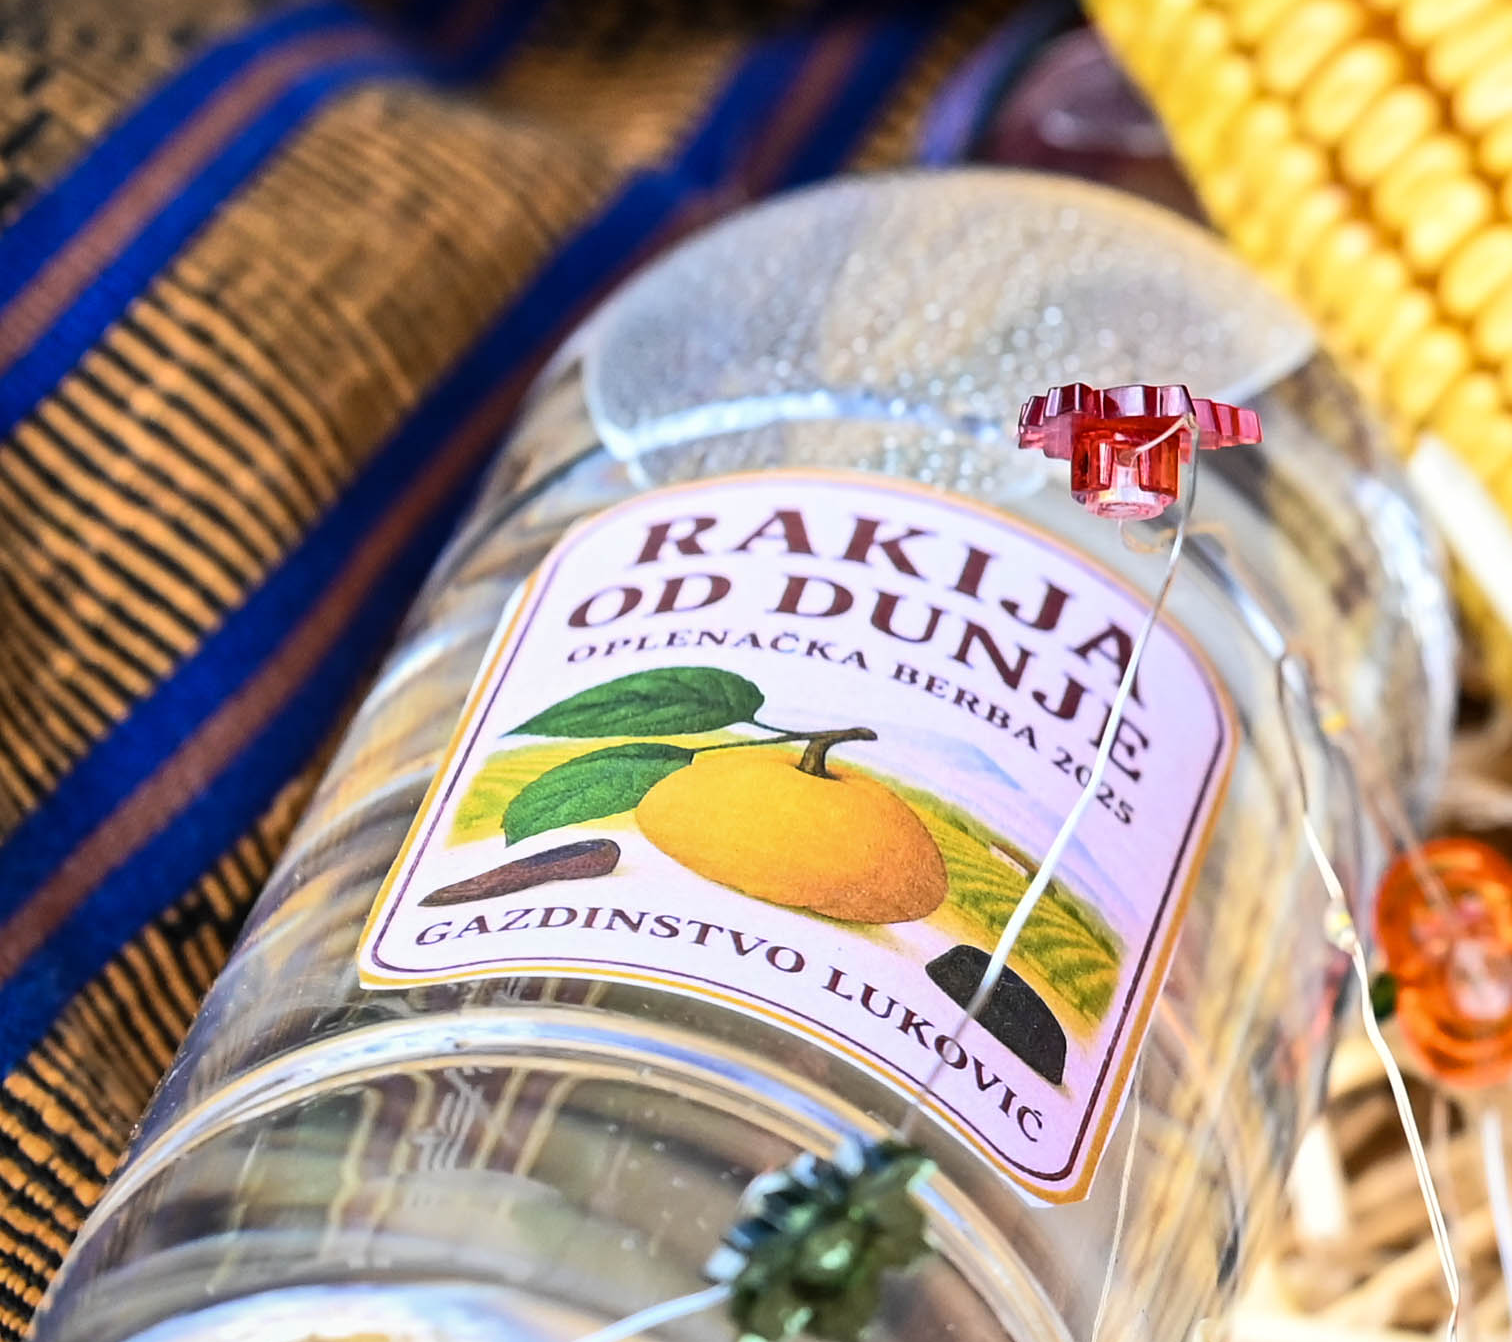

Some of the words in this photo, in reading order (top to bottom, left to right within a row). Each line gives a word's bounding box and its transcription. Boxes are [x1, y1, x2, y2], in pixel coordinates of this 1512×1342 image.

[566, 572, 732, 629] OD
[764, 573, 1151, 783] DUNJE
[626, 508, 1147, 709] RAKIJA
[566, 627, 869, 671] OPLENAČKA
[892, 662, 1040, 753] BERBA
[1050, 745, 1135, 827] 2025
[414, 906, 806, 974] GAZDINSTVO
[821, 965, 1043, 1143] LUKOVIĆ
